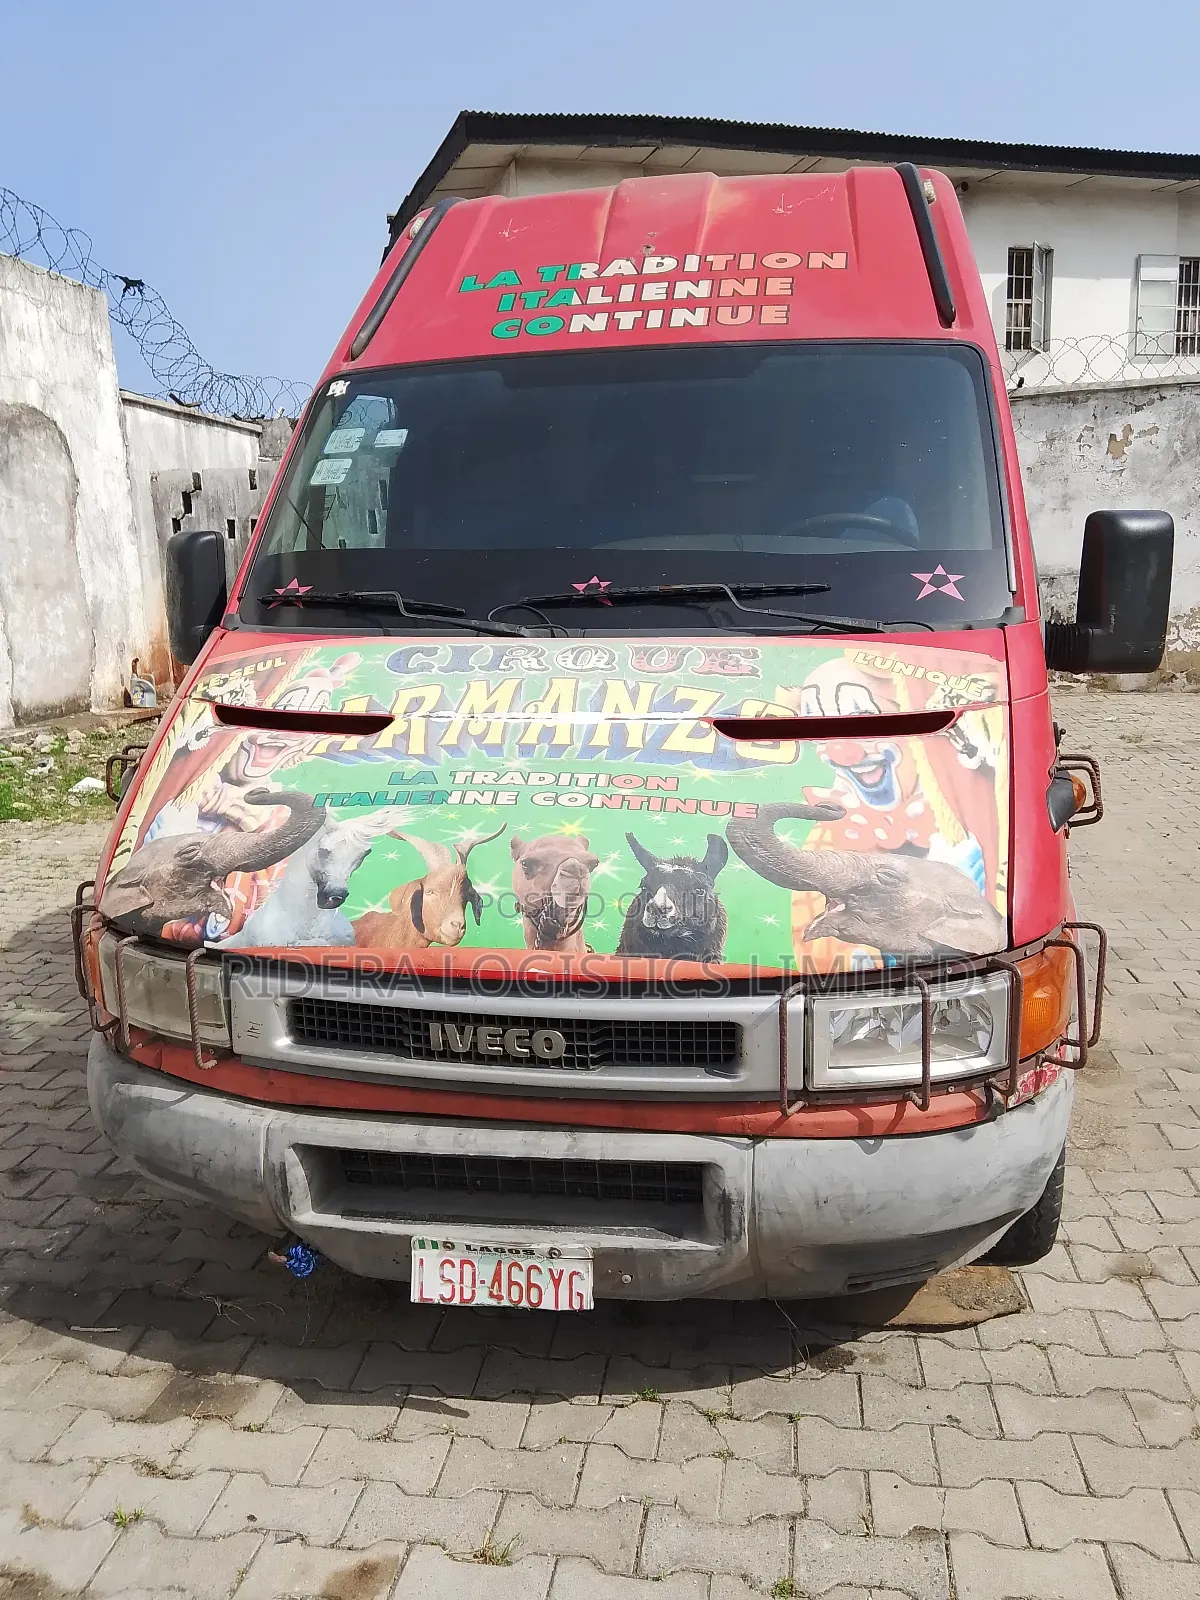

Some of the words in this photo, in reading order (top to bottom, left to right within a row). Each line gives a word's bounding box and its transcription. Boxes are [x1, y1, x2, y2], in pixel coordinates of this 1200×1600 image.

[458, 269, 524, 293] LA
[536, 252, 848, 284] TRADITION
[496, 277, 794, 313] ITALIENNE
[490, 305, 791, 340] CONTINUE
[228, 656, 287, 683] SEUL
[385, 643, 763, 679] CIRQUE
[853, 651, 986, 698] L'UNIQUE
[387, 769, 439, 787] LA
[450, 770, 680, 793] TRADITION
[312, 790, 519, 809] ITALIENNE
[530, 791, 760, 820] CONTINUE
[429, 1022, 567, 1060] IVECO
[465, 1244, 536, 1256] LAGOS
[418, 1257, 585, 1310] LSD-466YG
